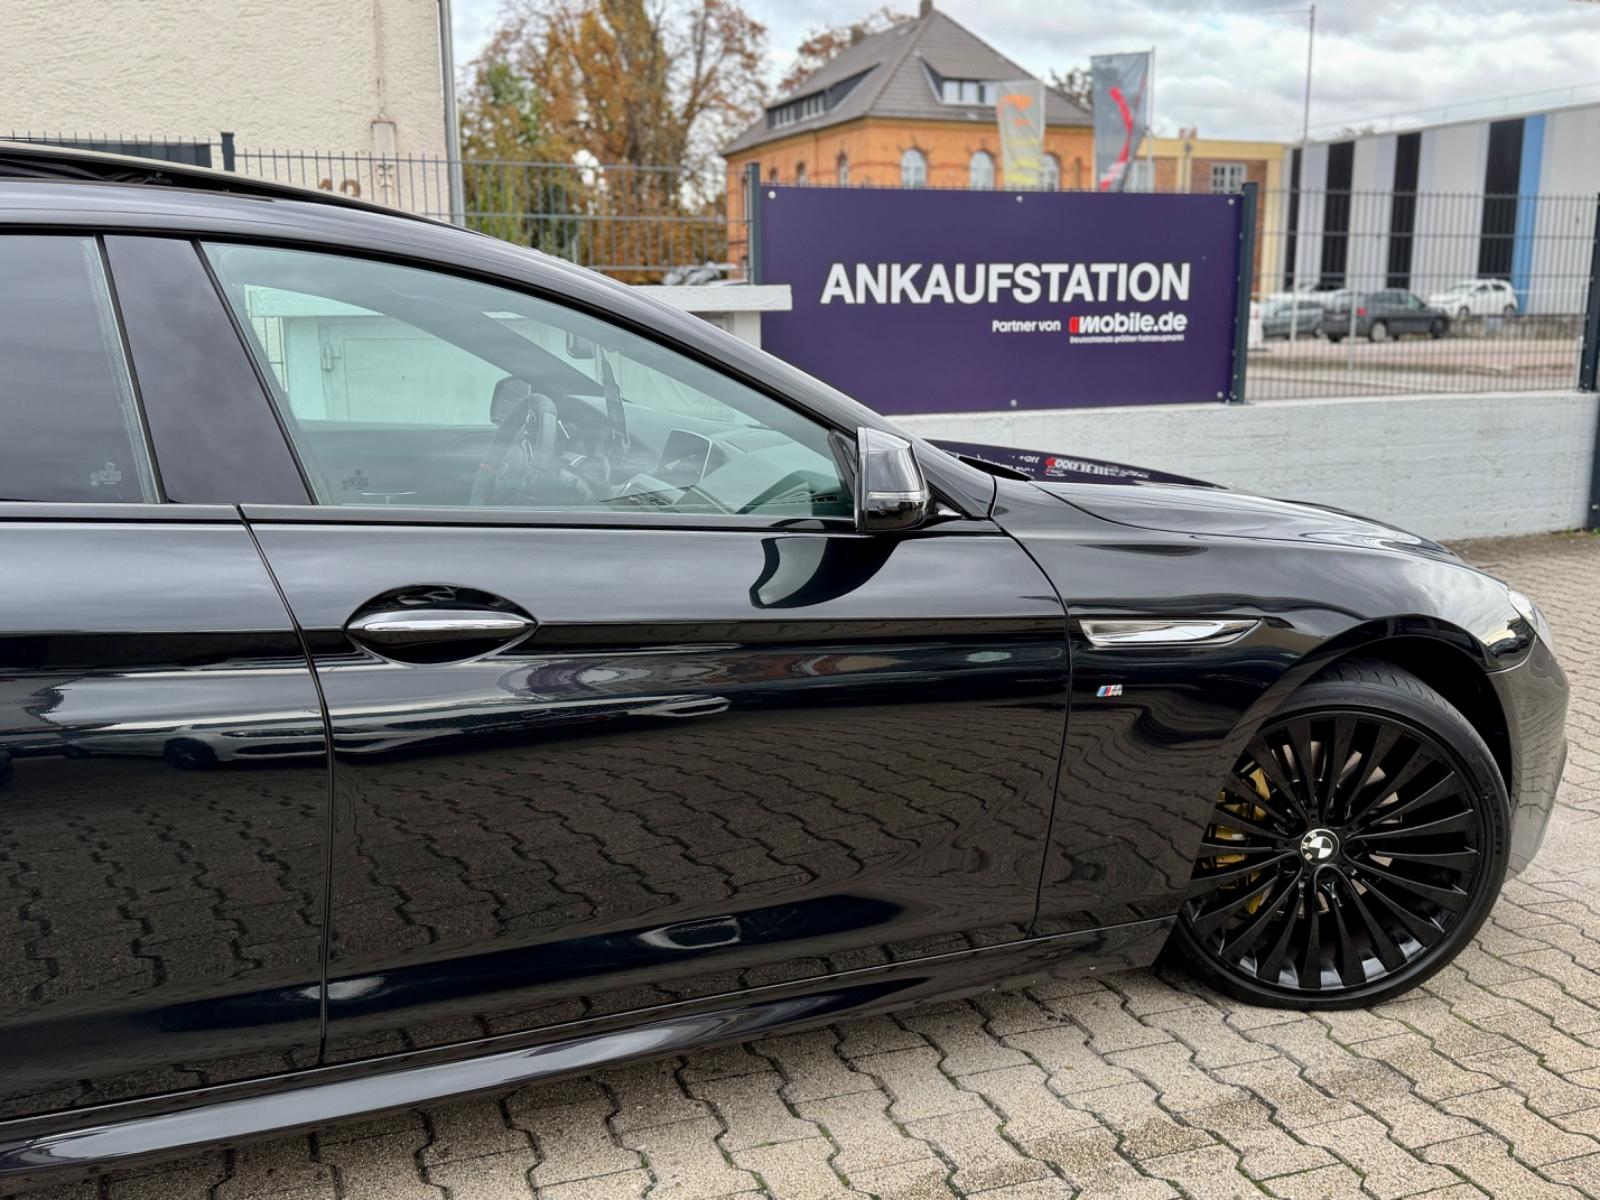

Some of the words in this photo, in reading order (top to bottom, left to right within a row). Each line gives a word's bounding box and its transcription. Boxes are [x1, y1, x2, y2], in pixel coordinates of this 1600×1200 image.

[820, 262, 1191, 304] ANKAUFSTATION
[992, 320, 1036, 333] Partner
[1038, 320, 1061, 332] von
[1077, 312, 1188, 334] mobile.de
